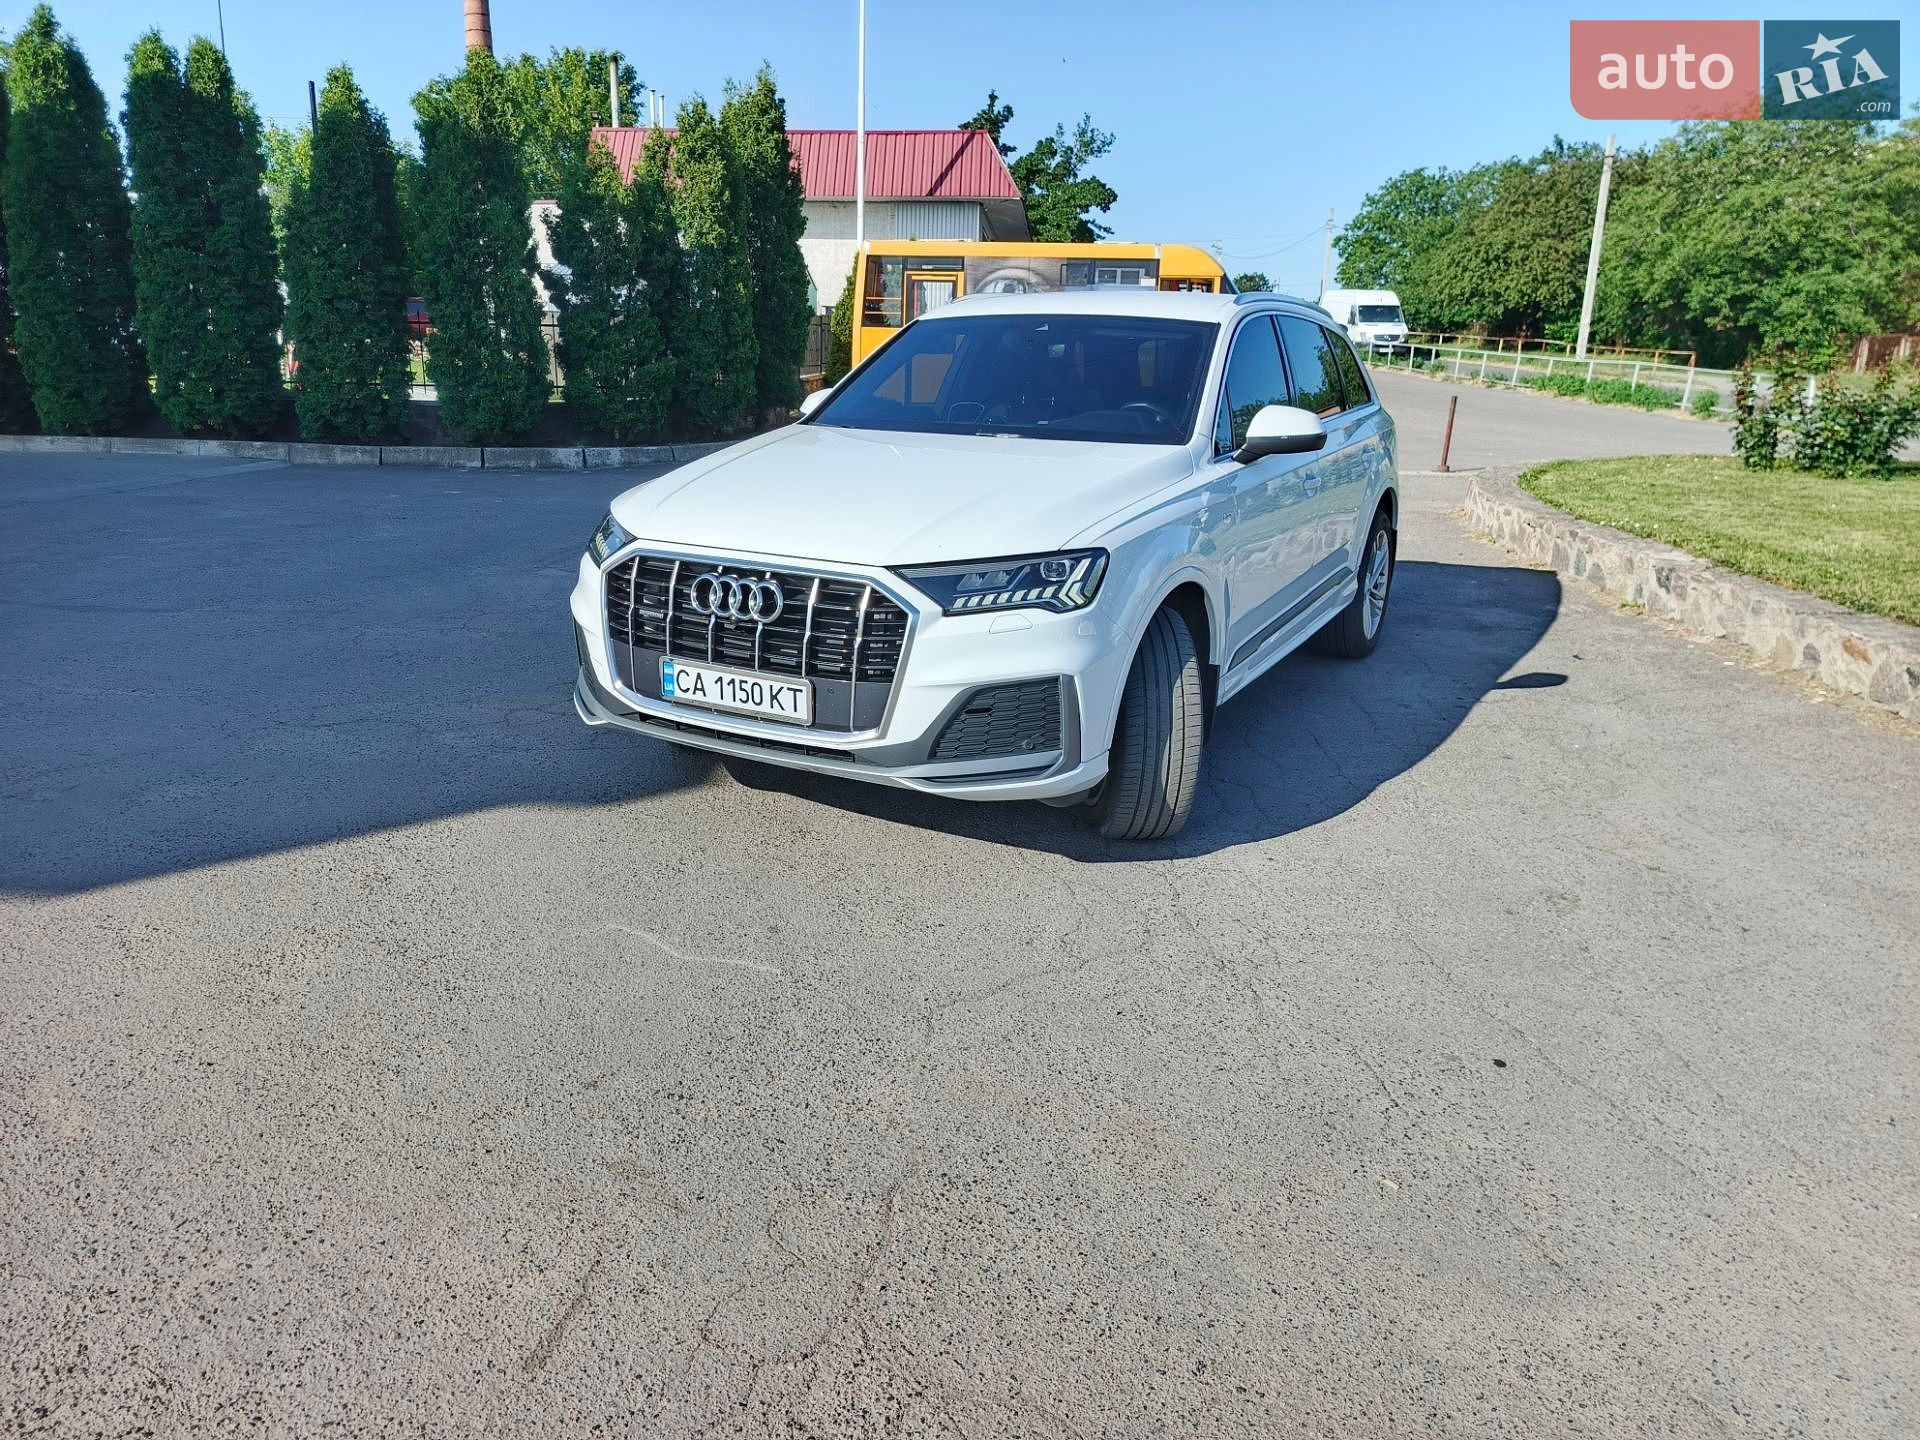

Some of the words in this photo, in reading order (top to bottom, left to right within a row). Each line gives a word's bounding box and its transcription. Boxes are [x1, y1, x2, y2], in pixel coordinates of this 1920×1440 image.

[676, 669, 707, 697] CA
[714, 676, 763, 706] 1150
[769, 684, 803, 713] KT
